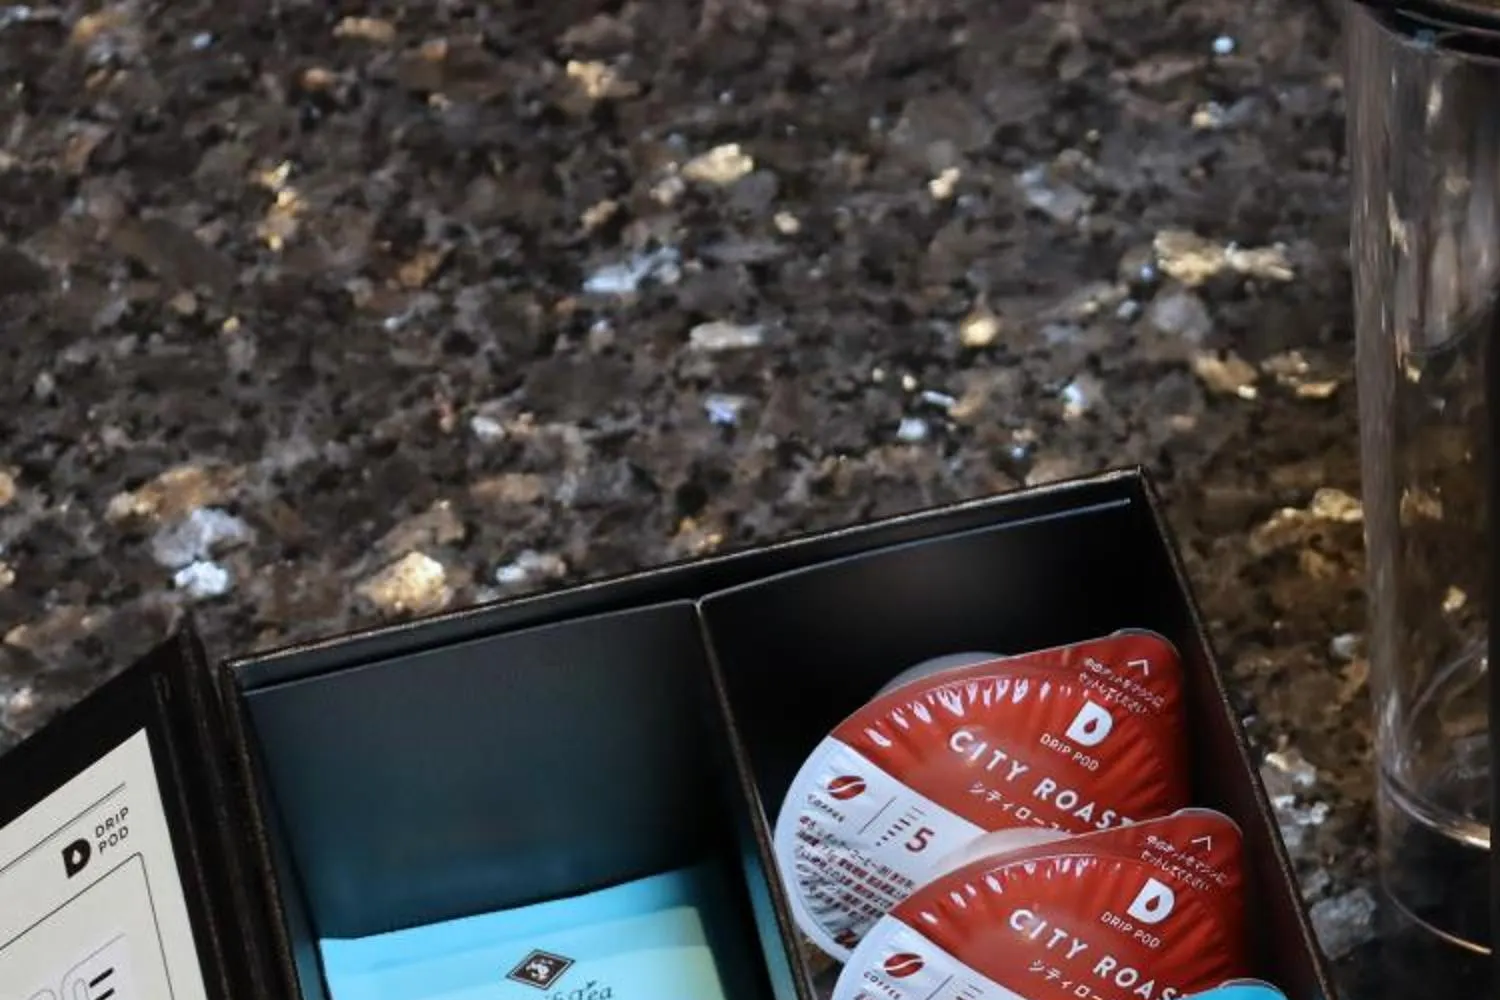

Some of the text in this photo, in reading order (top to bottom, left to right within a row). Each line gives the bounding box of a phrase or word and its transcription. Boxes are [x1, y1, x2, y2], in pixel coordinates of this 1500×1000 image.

[949, 729, 1030, 782] CITY
[1039, 732, 1099, 772] DRIP POD
[95, 806, 129, 838] DRIP
[98, 825, 129, 854] POD
[904, 826, 935, 853] 5
[1009, 908, 1089, 960] CITY
[1100, 911, 1161, 949] DRIP POD
